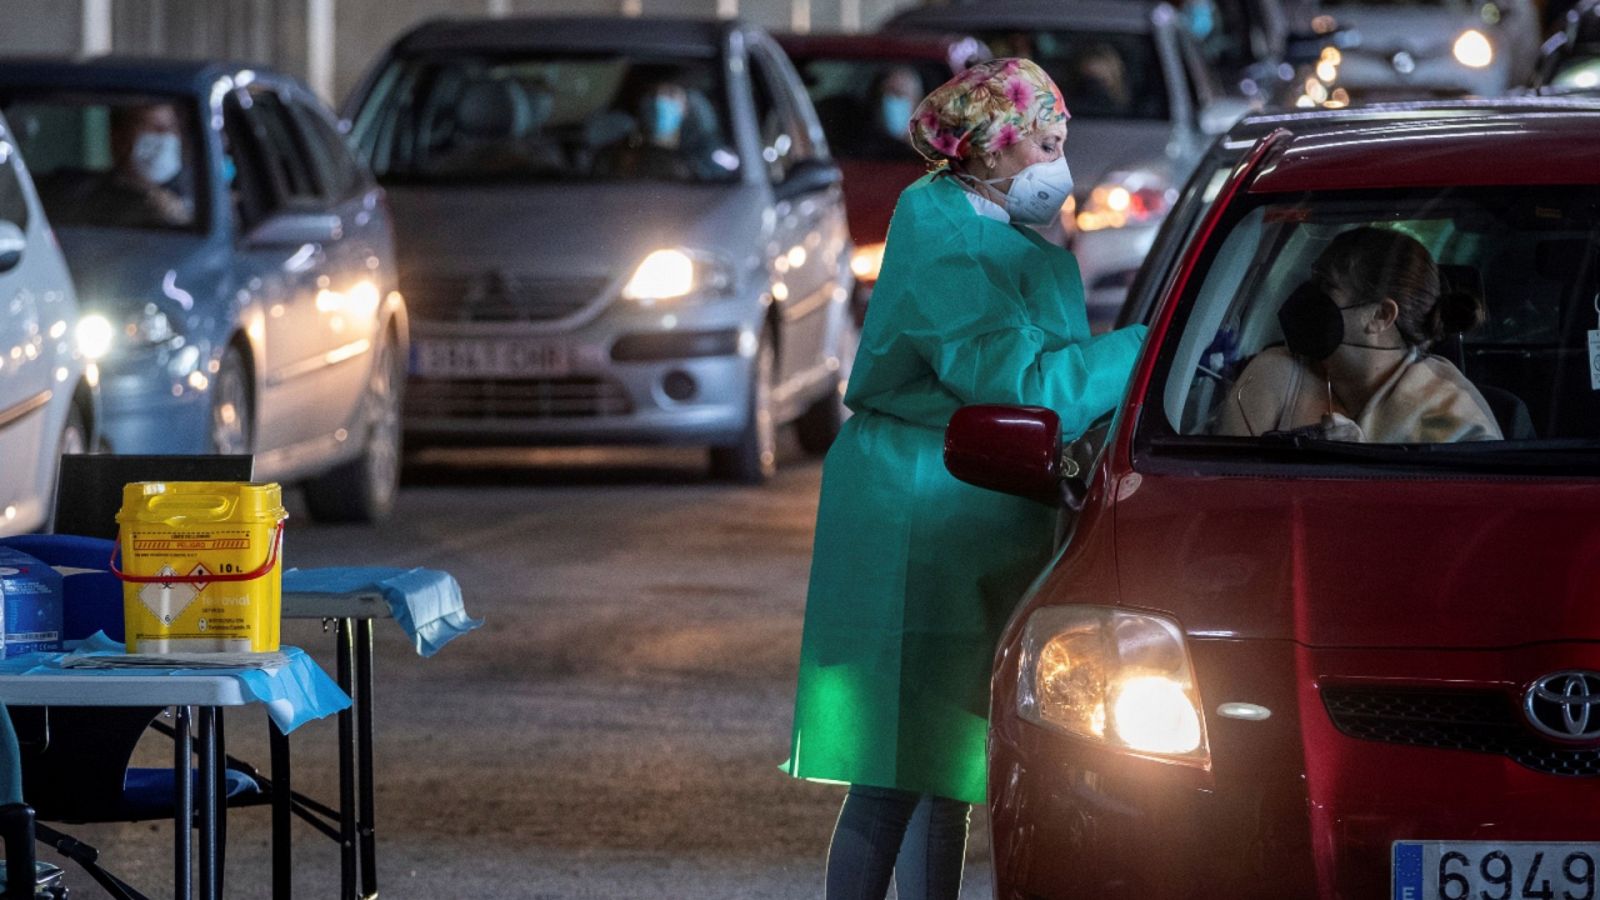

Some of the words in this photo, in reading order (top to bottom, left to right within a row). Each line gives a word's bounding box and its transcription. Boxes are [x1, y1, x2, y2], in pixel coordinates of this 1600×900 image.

[219, 563, 233, 573] 10
[164, 614, 171, 623] 6
[1402, 887, 1415, 900] E
[1438, 850, 1595, 900] 6949
